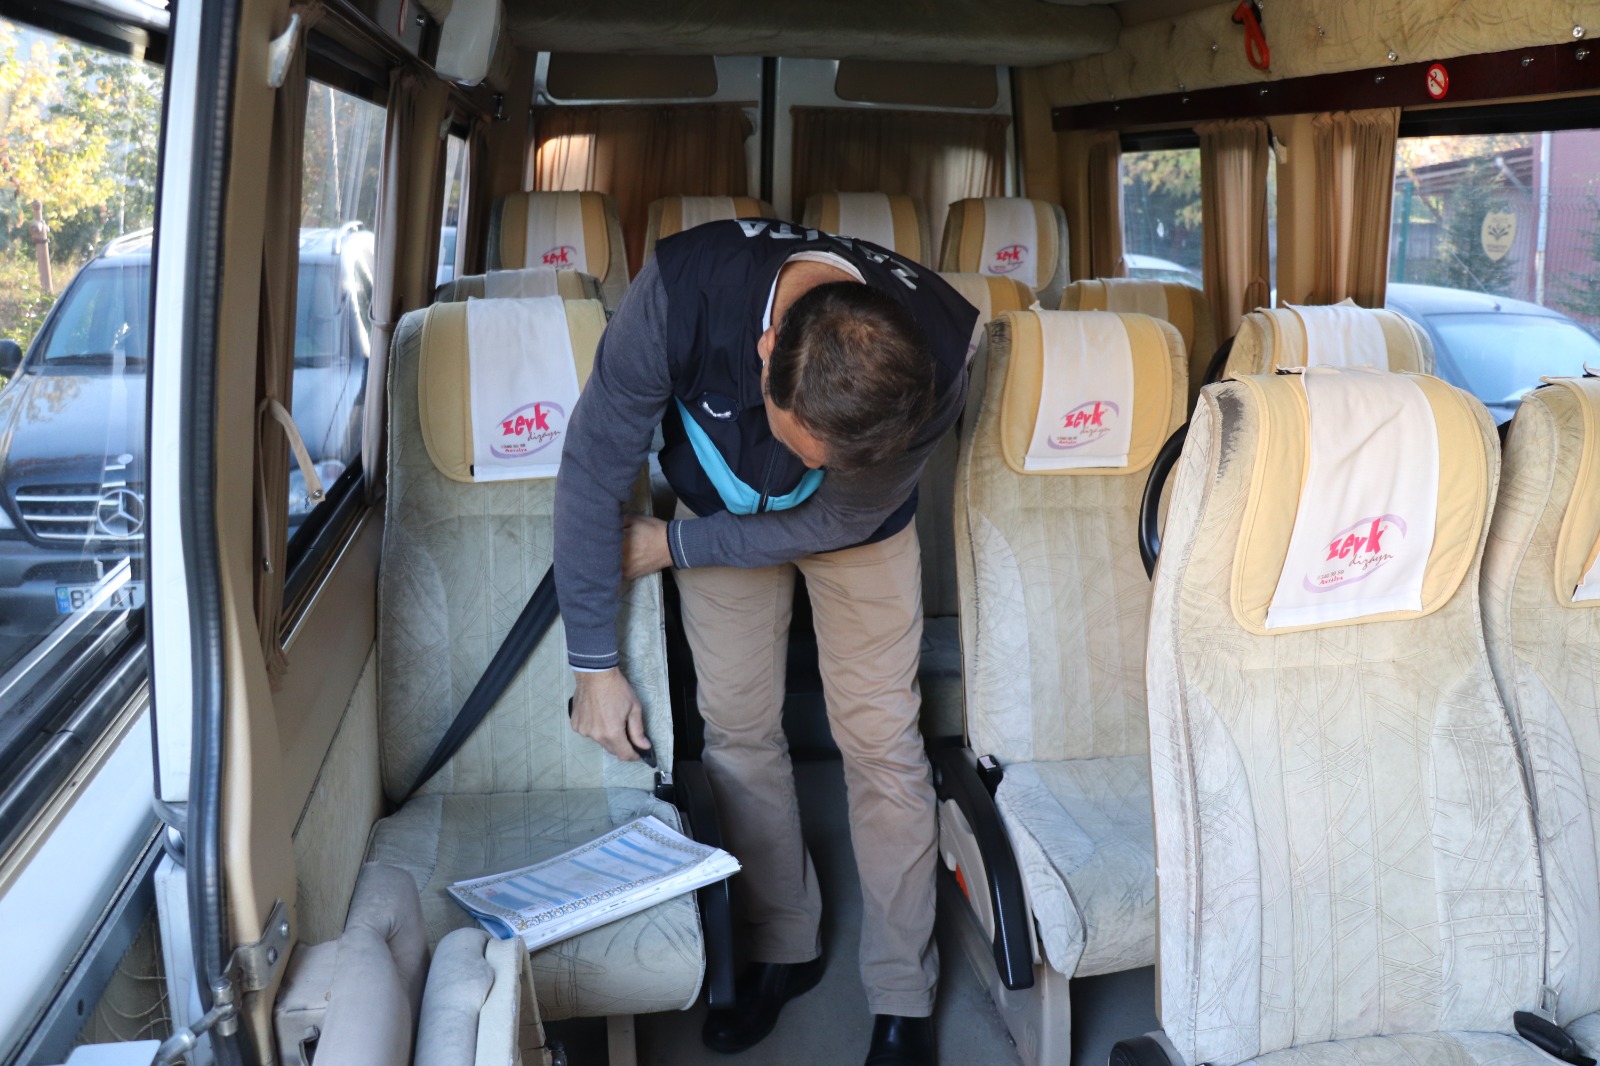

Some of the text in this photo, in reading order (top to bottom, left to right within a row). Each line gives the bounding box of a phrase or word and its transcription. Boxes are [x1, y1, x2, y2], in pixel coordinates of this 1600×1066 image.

[502, 402, 550, 436] zevk
[1063, 401, 1106, 429] zevk
[1325, 517, 1386, 561] zevk
[1348, 553, 1394, 570] dizayn
